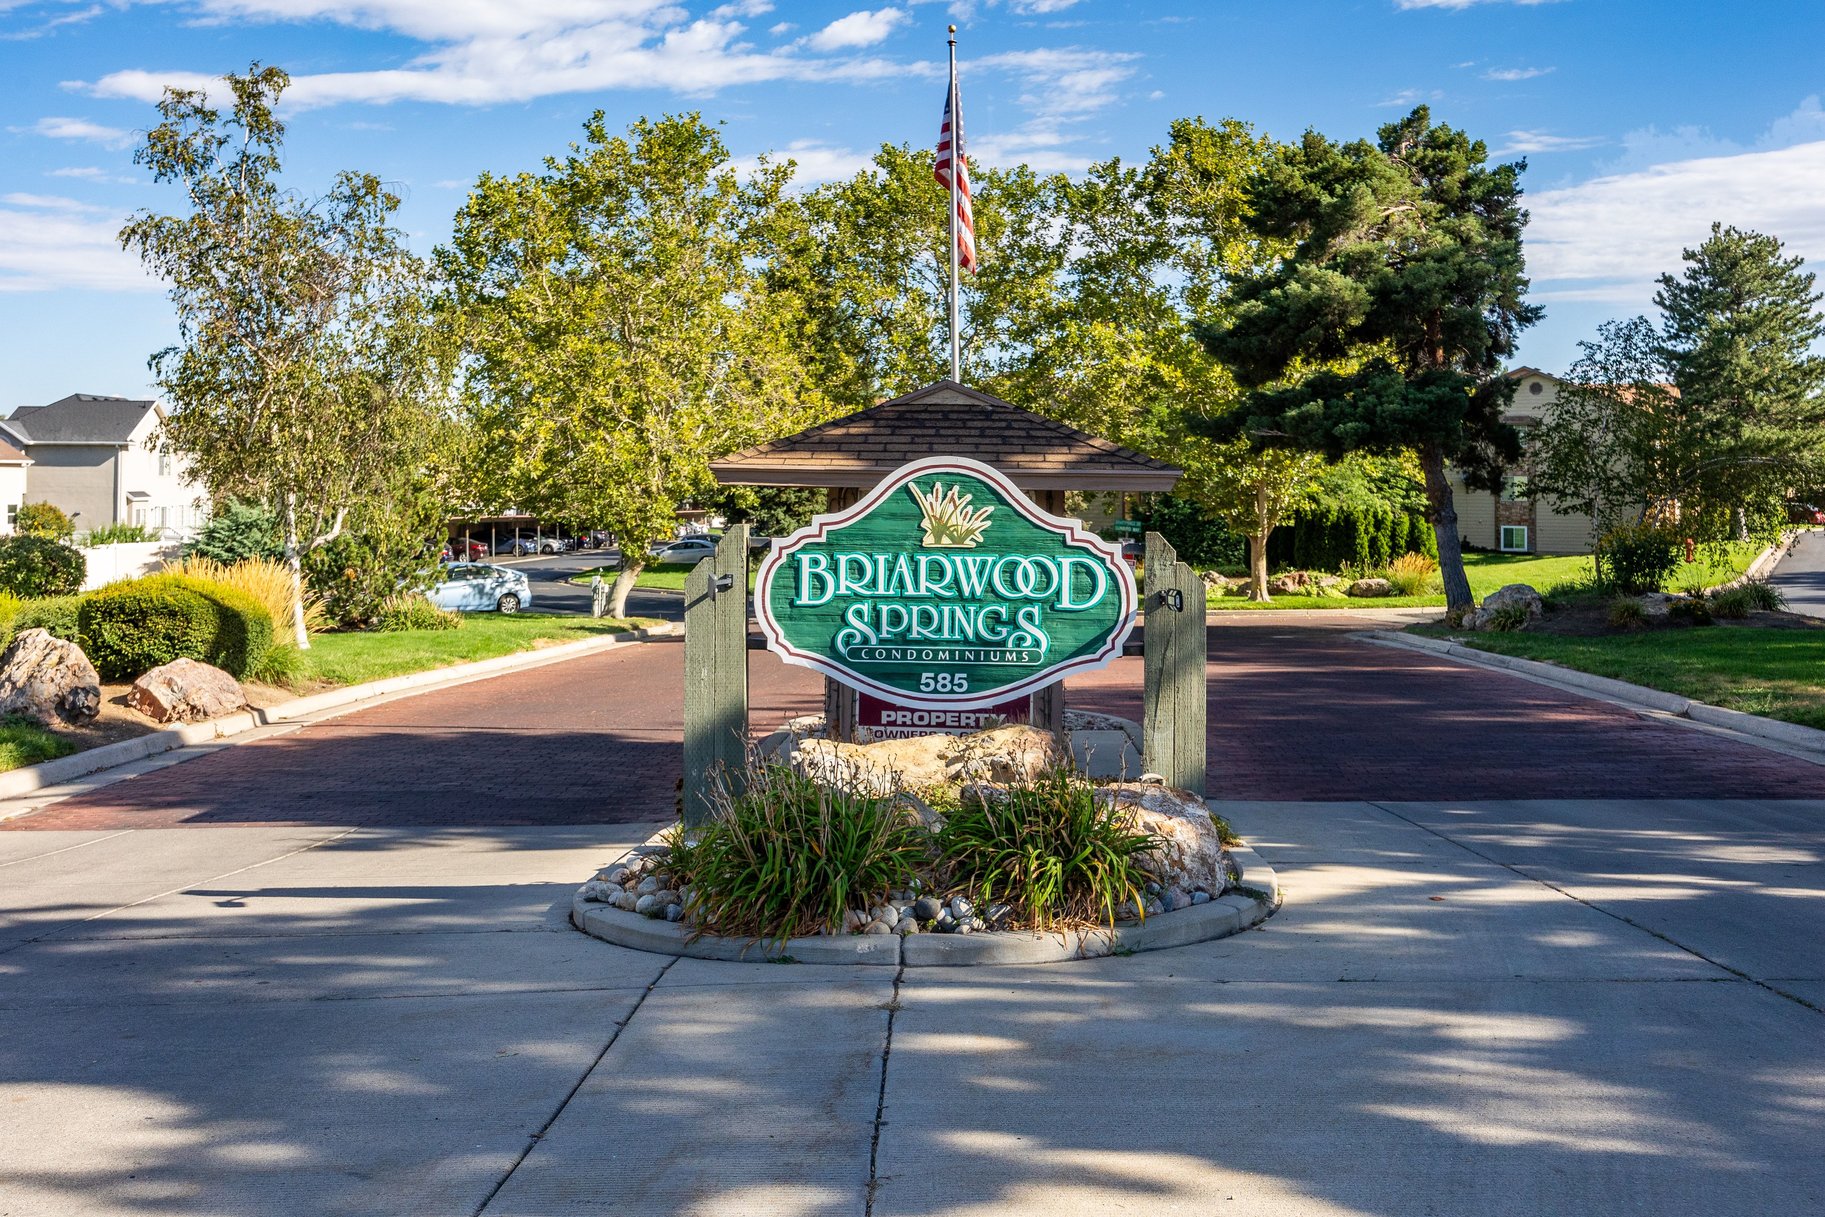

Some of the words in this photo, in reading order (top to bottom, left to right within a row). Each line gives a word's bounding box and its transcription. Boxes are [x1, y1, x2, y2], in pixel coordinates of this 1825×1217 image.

[795, 552, 1108, 610] BRIARWOOD
[835, 601, 1050, 656] SPRINGS
[860, 647, 1030, 662] CONDOMINIUMS
[919, 671, 969, 693] 585
[881, 710, 1007, 728] PROPERTY
